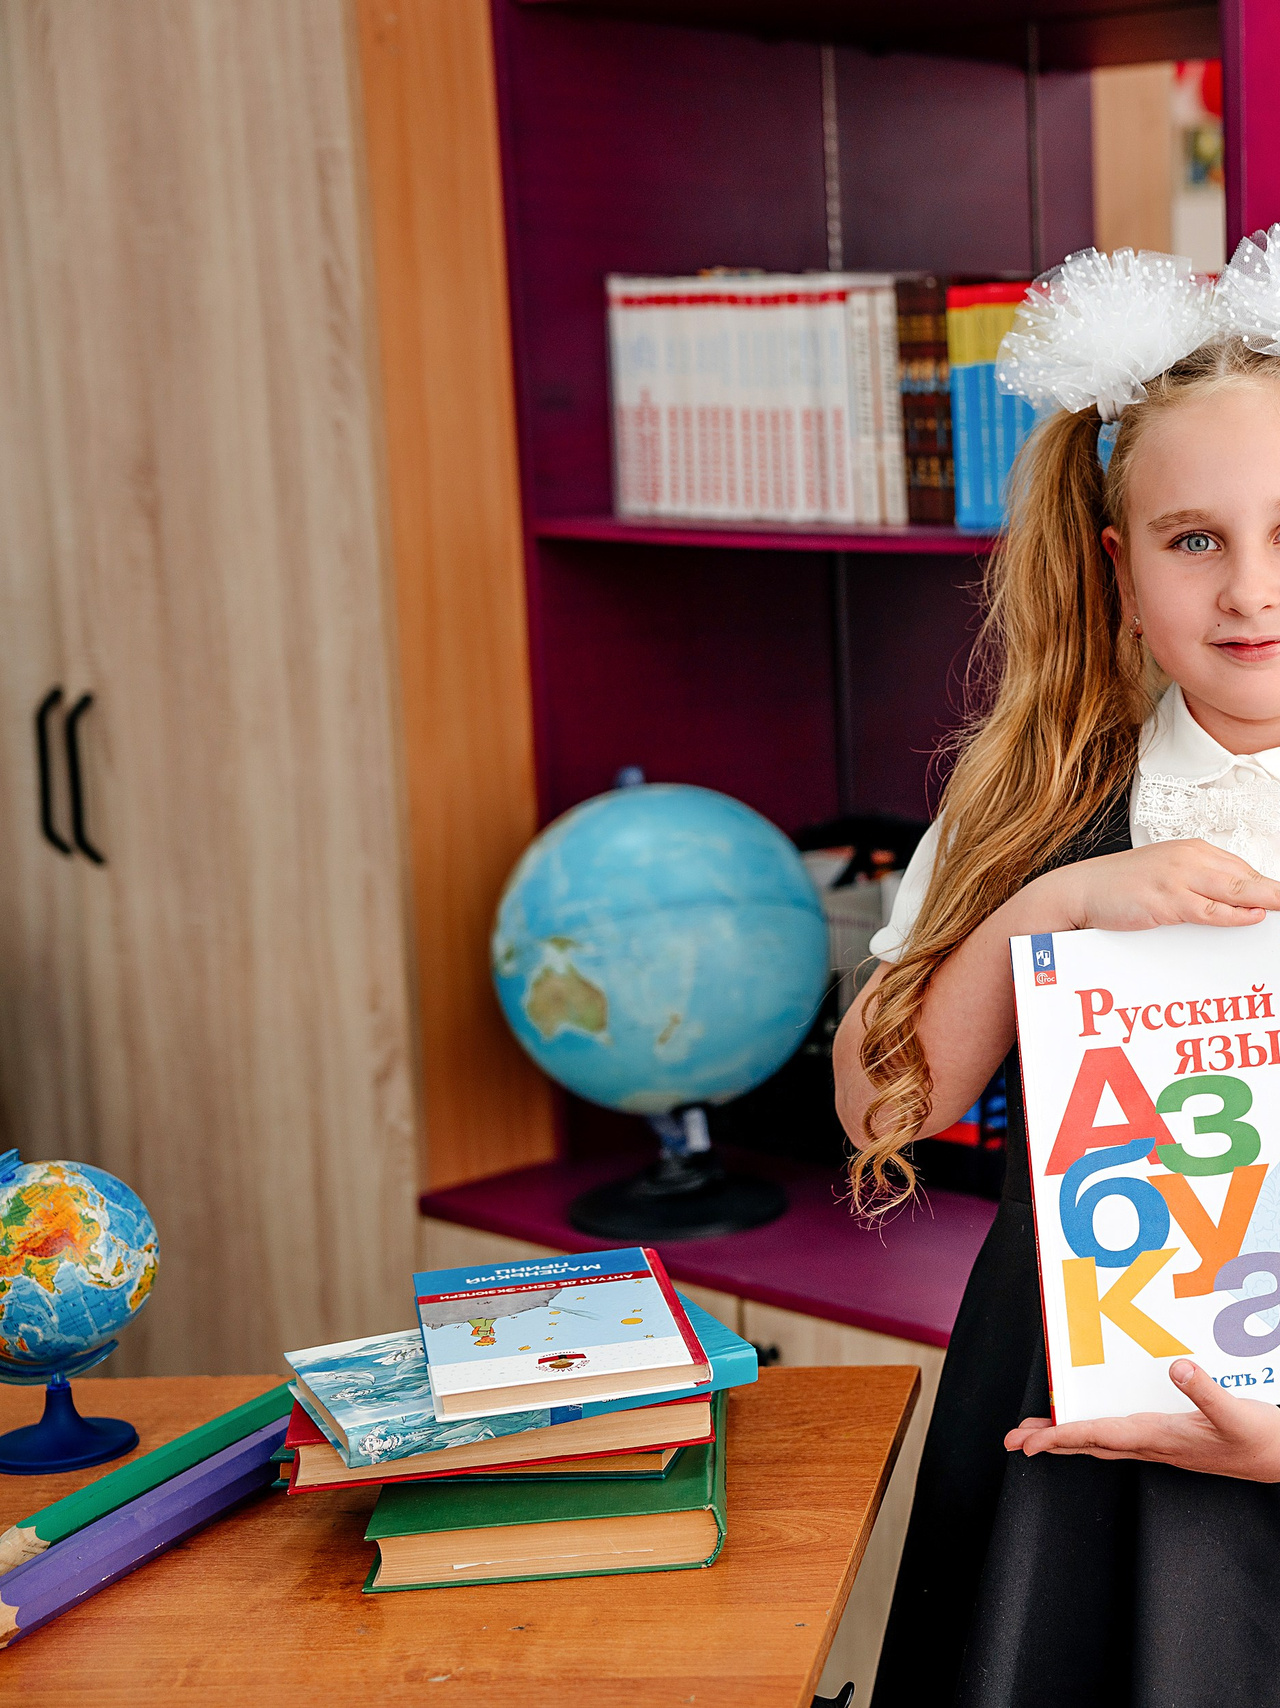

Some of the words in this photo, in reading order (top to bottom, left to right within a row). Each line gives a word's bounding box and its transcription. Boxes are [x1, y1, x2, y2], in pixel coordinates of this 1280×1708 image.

[1075, 983, 1275, 1043] Русский
[466, 1263, 602, 1285] МАЛЕНЬКИЙ
[494, 1262, 569, 1275] ПРИНЦ
[580, 1273, 634, 1284] АНТУАН
[1211, 1373, 1257, 1388] сть
[1261, 1367, 1275, 1384] 2
